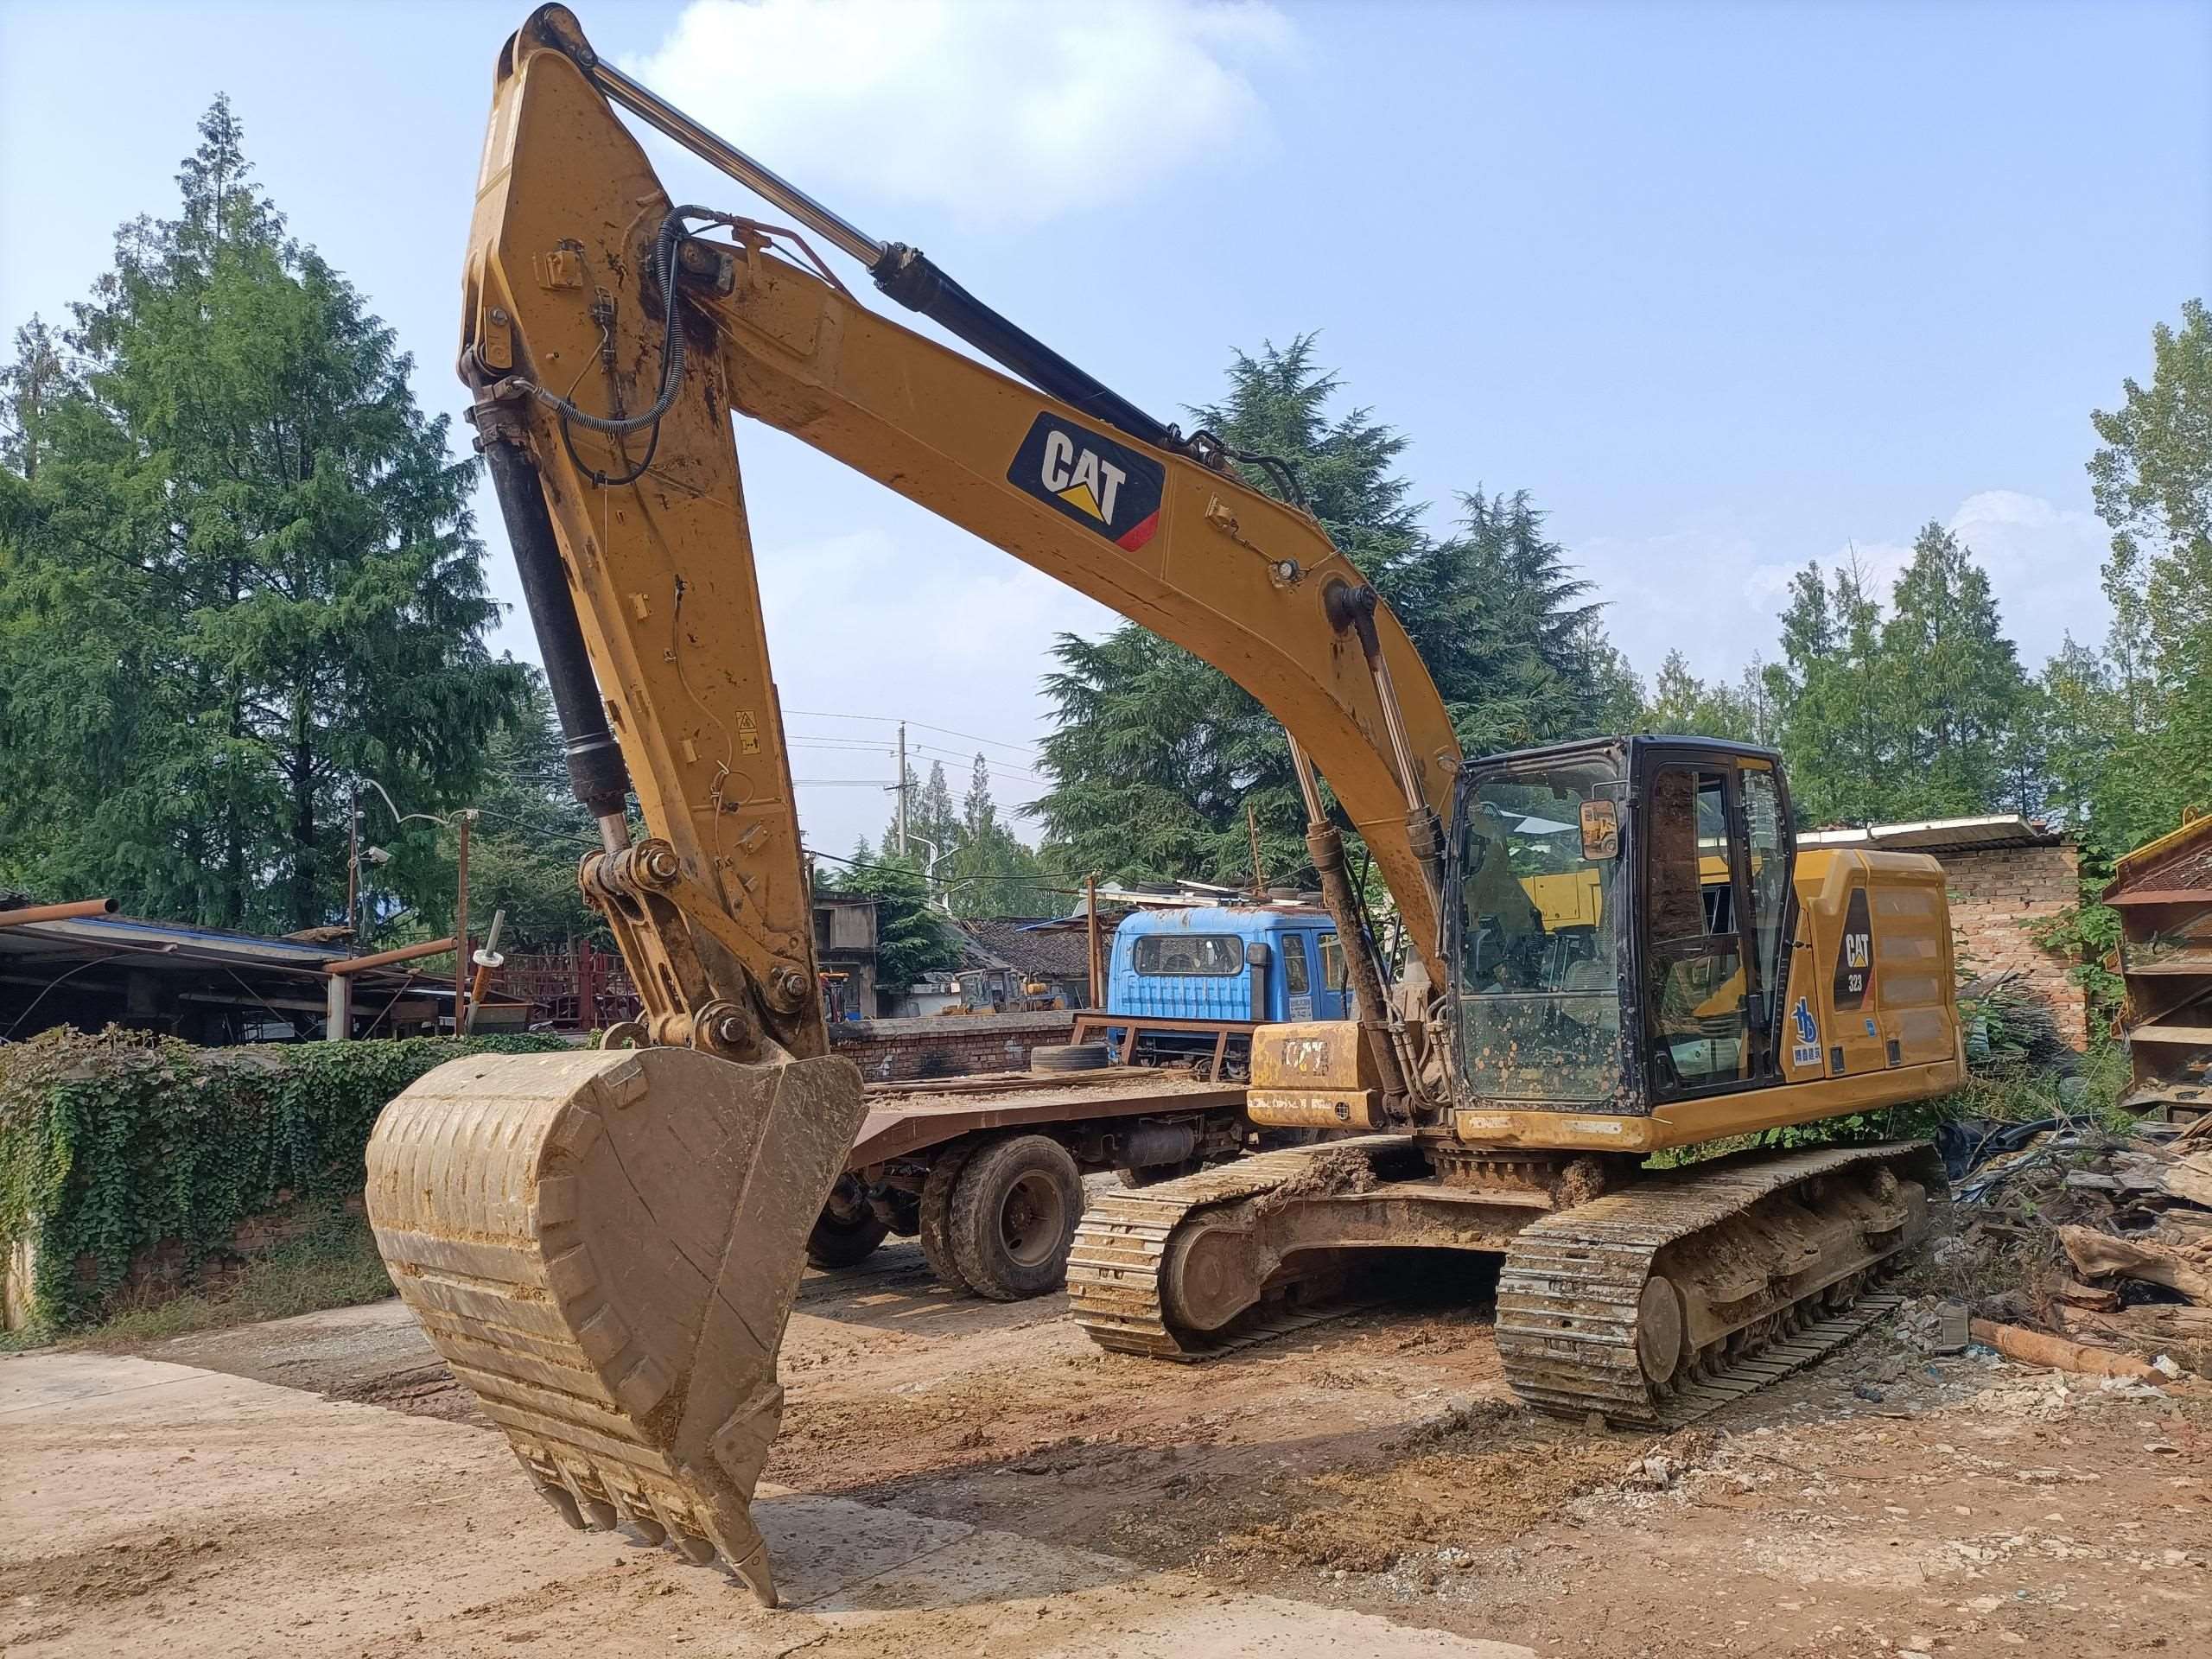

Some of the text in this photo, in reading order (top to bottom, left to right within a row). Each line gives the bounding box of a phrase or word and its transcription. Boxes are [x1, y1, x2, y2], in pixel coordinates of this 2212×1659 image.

[1041, 430, 1126, 525] CAT
[1846, 934, 1868, 967] CAT
[1848, 974, 1862, 992] 323
